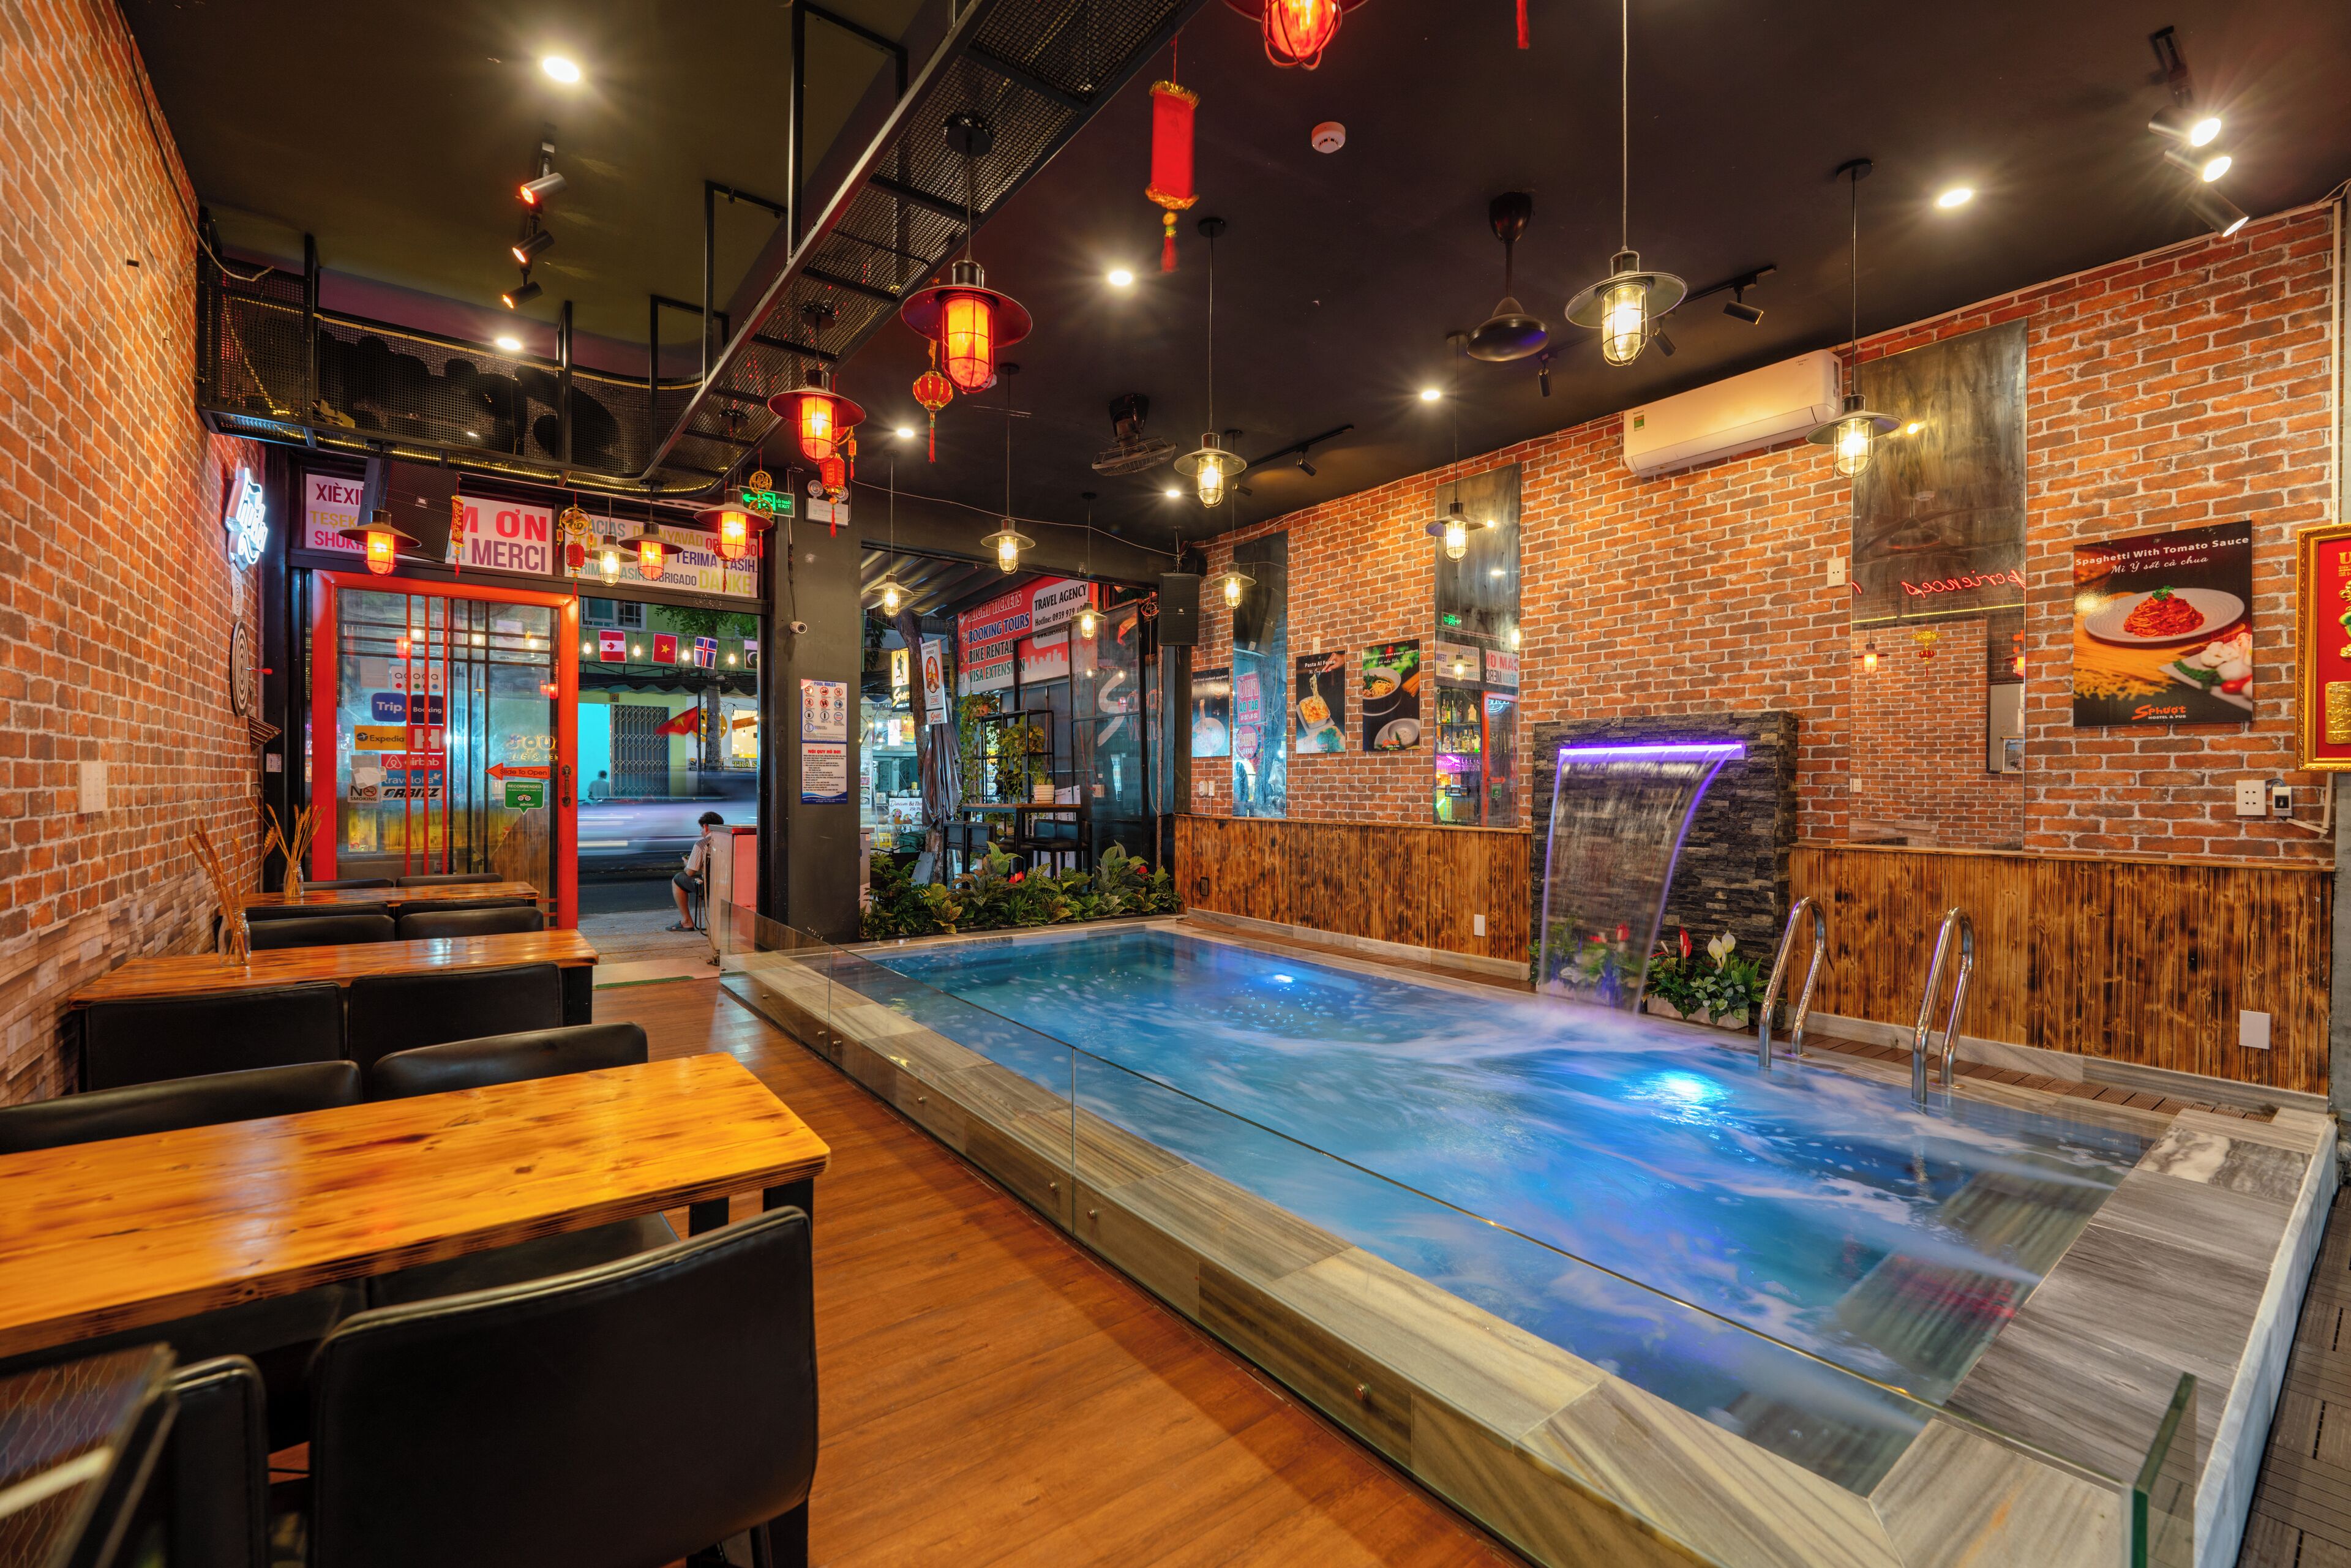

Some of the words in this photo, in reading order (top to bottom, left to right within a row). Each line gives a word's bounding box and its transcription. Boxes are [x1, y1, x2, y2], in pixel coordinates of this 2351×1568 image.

[496, 509, 547, 542] ƠN
[471, 538, 546, 572] MERCI
[675, 550, 718, 568] TERIMA
[2075, 552, 2130, 566] Spaghetti
[2133, 548, 2160, 558] With
[2163, 542, 2208, 555] Tomato
[2211, 536, 2249, 548] Sauce
[2110, 564, 2126, 574] Mì
[2129, 560, 2140, 573] Ý
[2143, 560, 2161, 571] sốt
[2164, 559, 2177, 568] cà
[2180, 555, 2209, 566] chua
[699, 569, 752, 594] DANKE
[992, 590, 1022, 615] TICKETS
[1034, 593, 1057, 612] TRAVEL
[1059, 583, 1087, 603] AGENCY
[968, 622, 1002, 643] BOOKING
[1003, 612, 1030, 632] TOURS
[1052, 610, 1065, 622] 0939
[968, 647, 984, 664] BIKE
[968, 667, 984, 684] VISA
[985, 657, 1026, 680] EXTENSIN
[369, 735, 405, 743] Expedia
[732, 758, 751, 768] TRÀ
